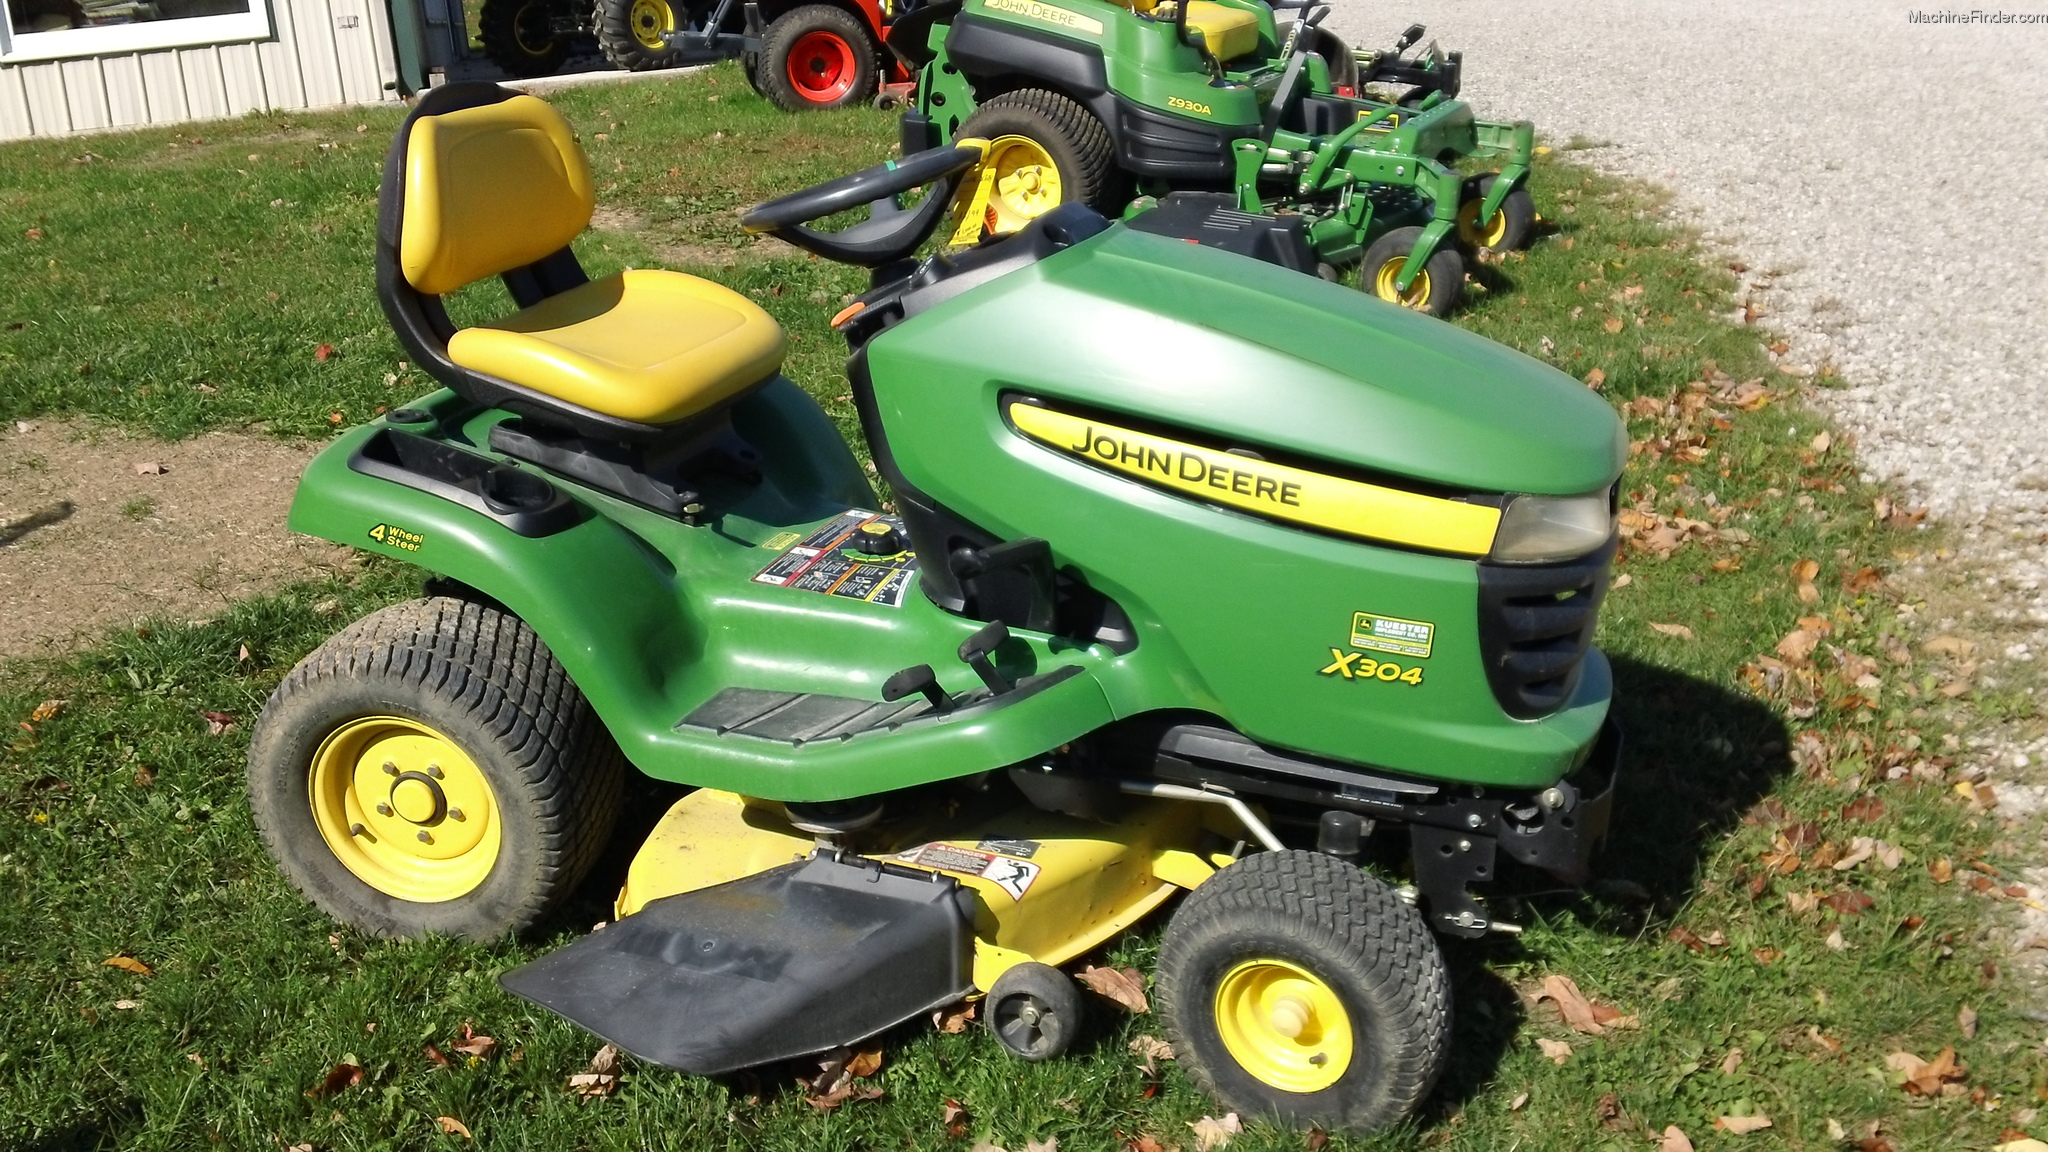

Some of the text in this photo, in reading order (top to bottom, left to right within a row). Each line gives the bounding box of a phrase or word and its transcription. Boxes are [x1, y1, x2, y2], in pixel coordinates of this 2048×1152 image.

[1031, 3, 1077, 25] DEERE
[1167, 96, 1212, 116] Z930A
[1072, 426, 1302, 507] JOHN DEERE
[369, 524, 386, 542] 4
[389, 526, 424, 543] Wheel
[386, 535, 420, 552] Steer
[1375, 619, 1430, 634] KUESTER
[1320, 648, 1424, 685] X304
[949, 848, 987, 859] DANGER
